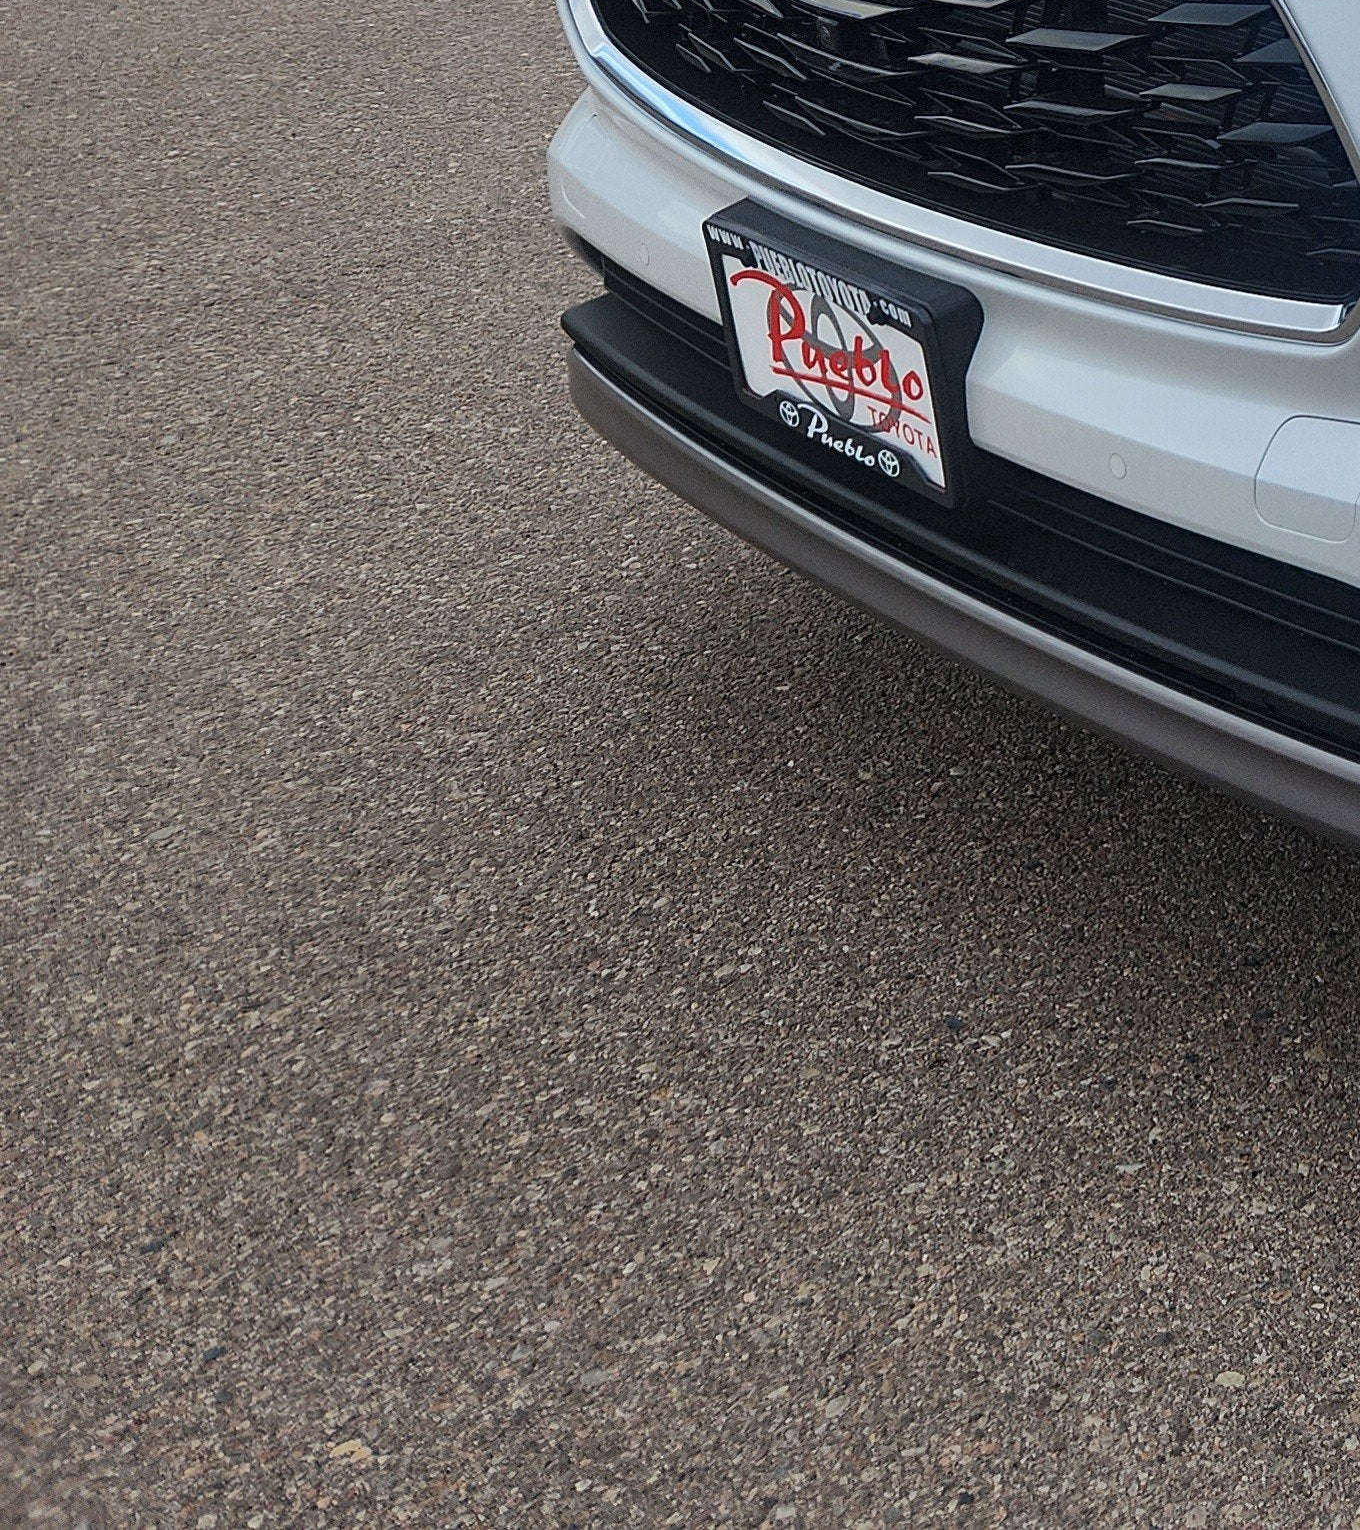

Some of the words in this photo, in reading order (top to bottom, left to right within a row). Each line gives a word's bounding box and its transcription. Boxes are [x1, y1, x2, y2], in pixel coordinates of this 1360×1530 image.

[729, 269, 924, 401] Pueblo
[797, 403, 876, 468] Pueblo
[867, 405, 938, 459] TOYOTA
